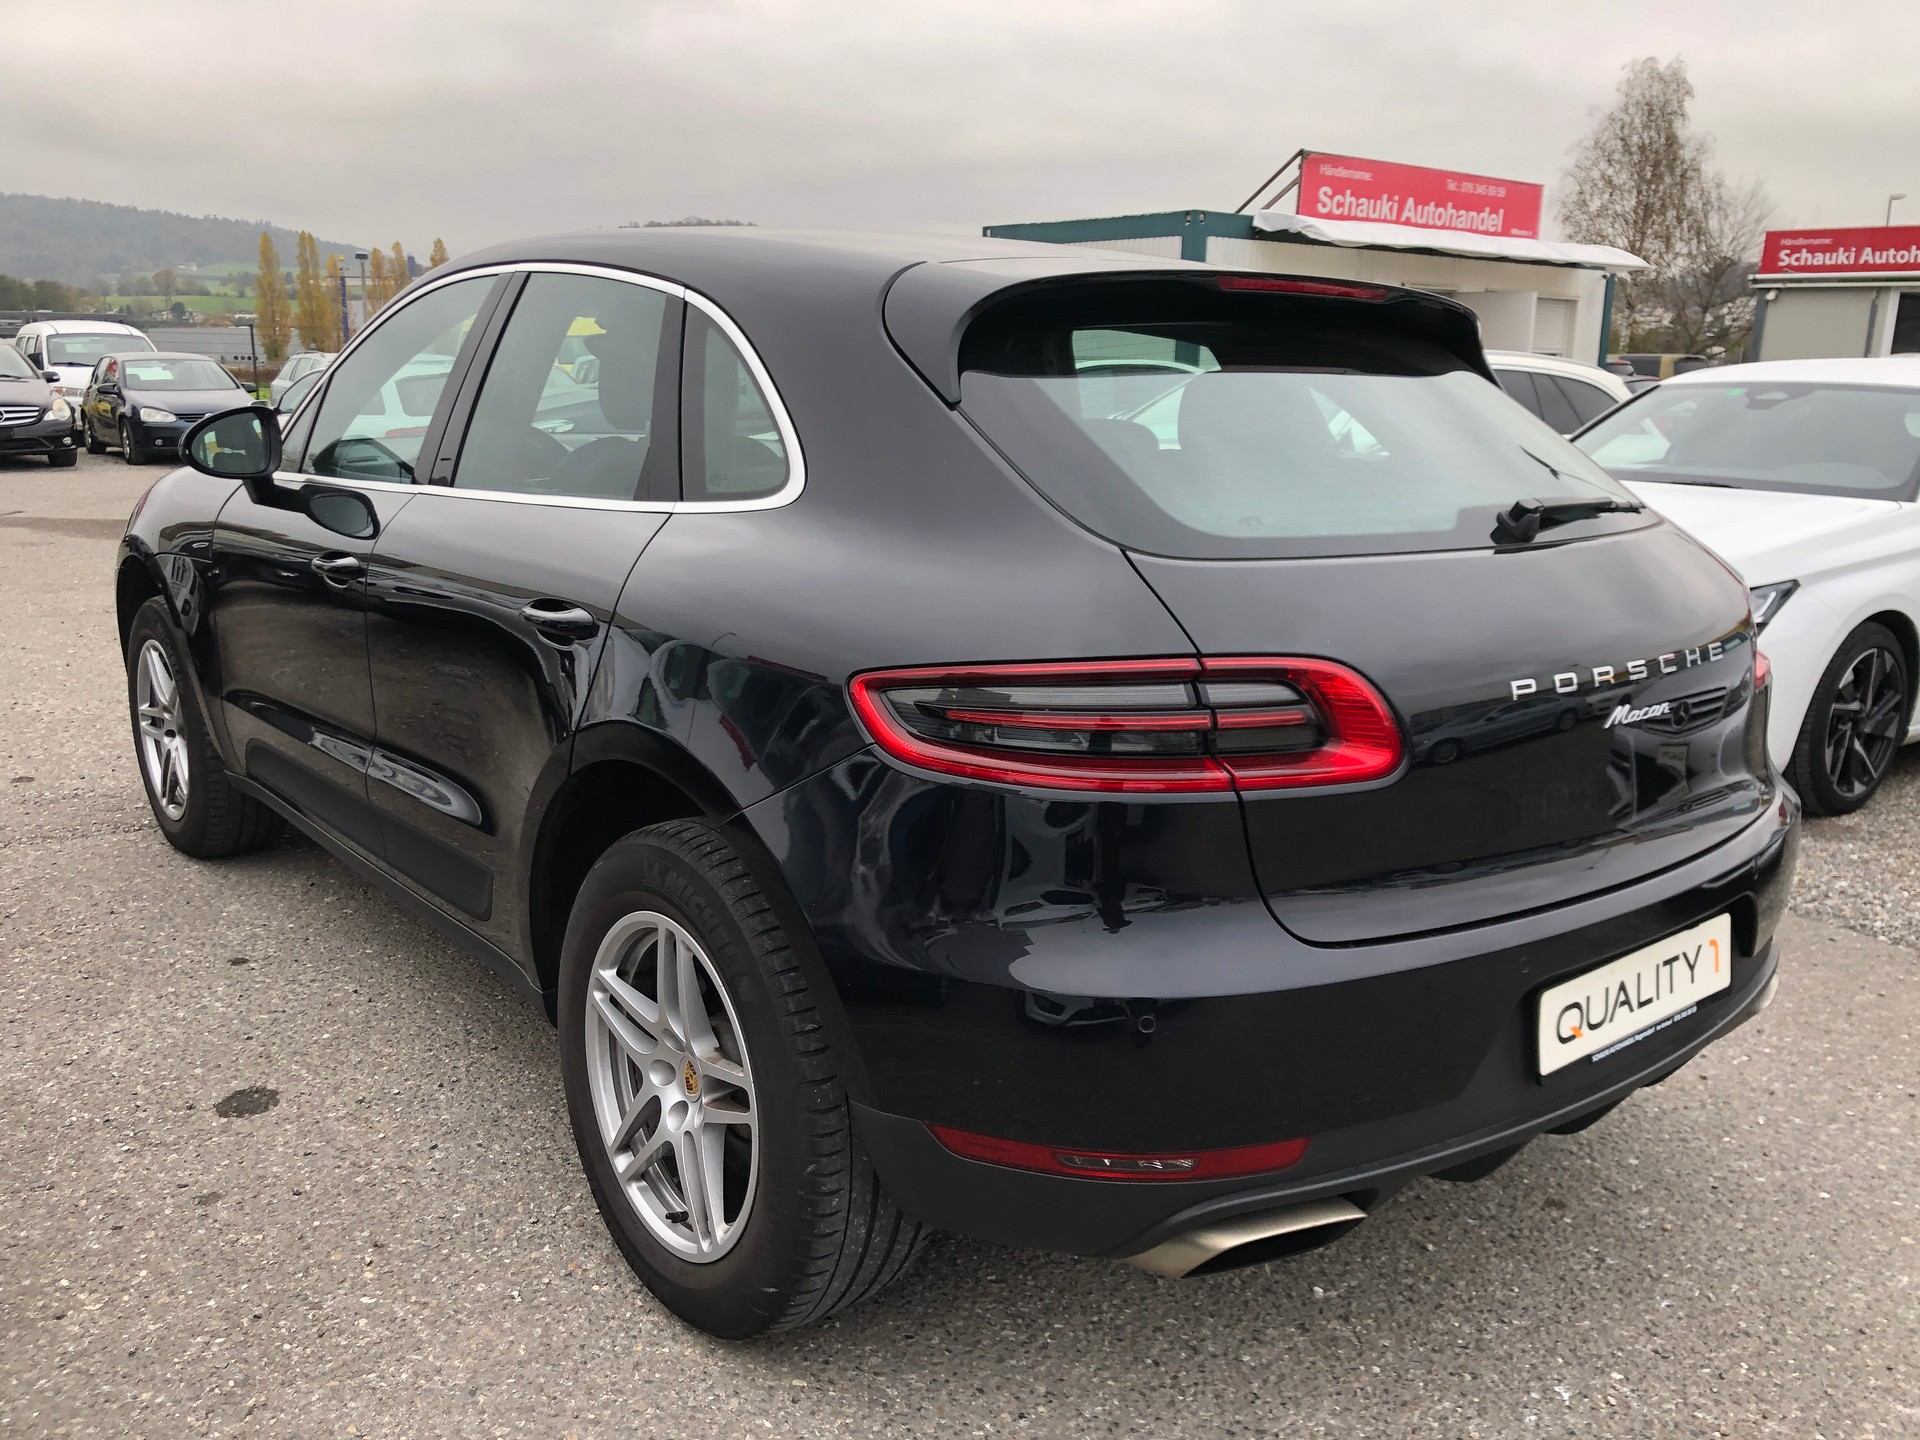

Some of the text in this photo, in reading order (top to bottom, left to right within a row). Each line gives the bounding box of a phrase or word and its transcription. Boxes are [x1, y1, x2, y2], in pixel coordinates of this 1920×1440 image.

[1316, 186, 1505, 233] Schauki Autohandel
[1778, 246, 1857, 267] Schauki
[1510, 641, 1724, 702] PORSCHE
[1602, 701, 1672, 730] Macan
